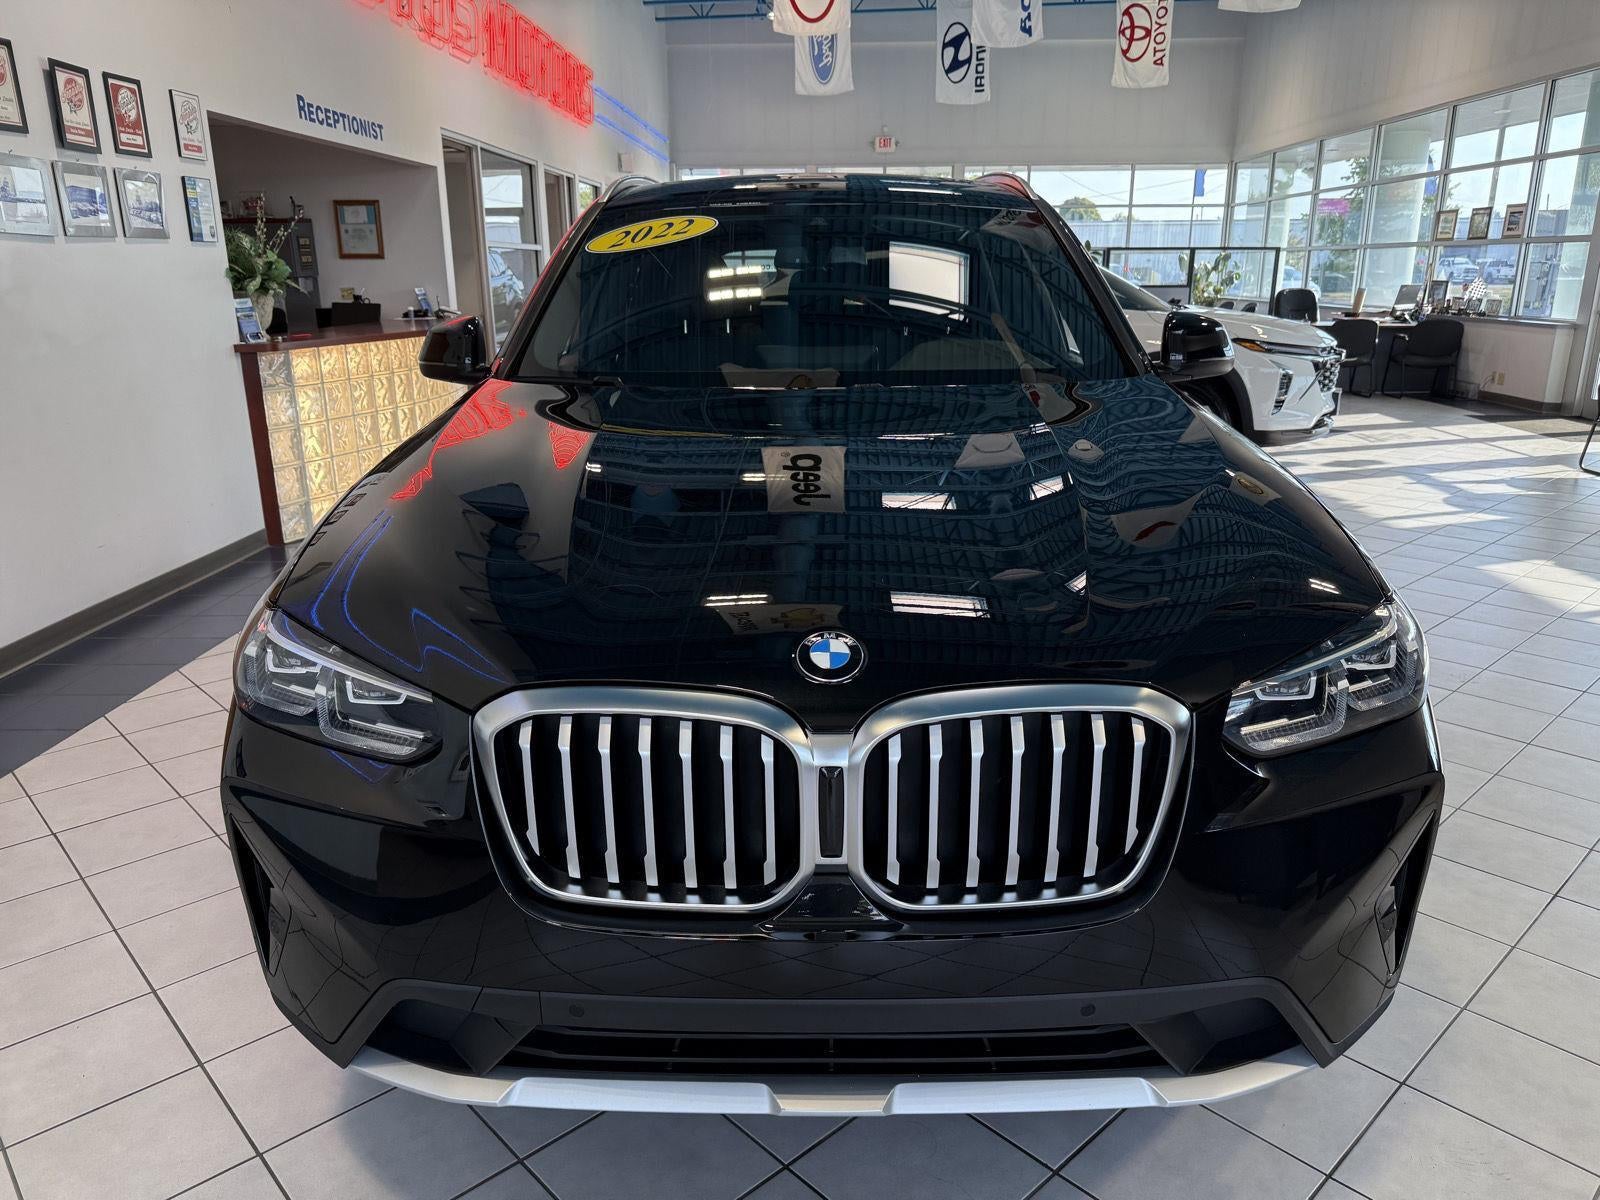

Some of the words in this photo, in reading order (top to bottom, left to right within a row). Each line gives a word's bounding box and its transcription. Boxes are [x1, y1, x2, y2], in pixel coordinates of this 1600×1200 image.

[484, 0, 593, 125] MOTORS
[296, 94, 384, 141] RECEPTIONIST
[879, 138, 892, 148] EXIT
[608, 219, 695, 249] 2022
